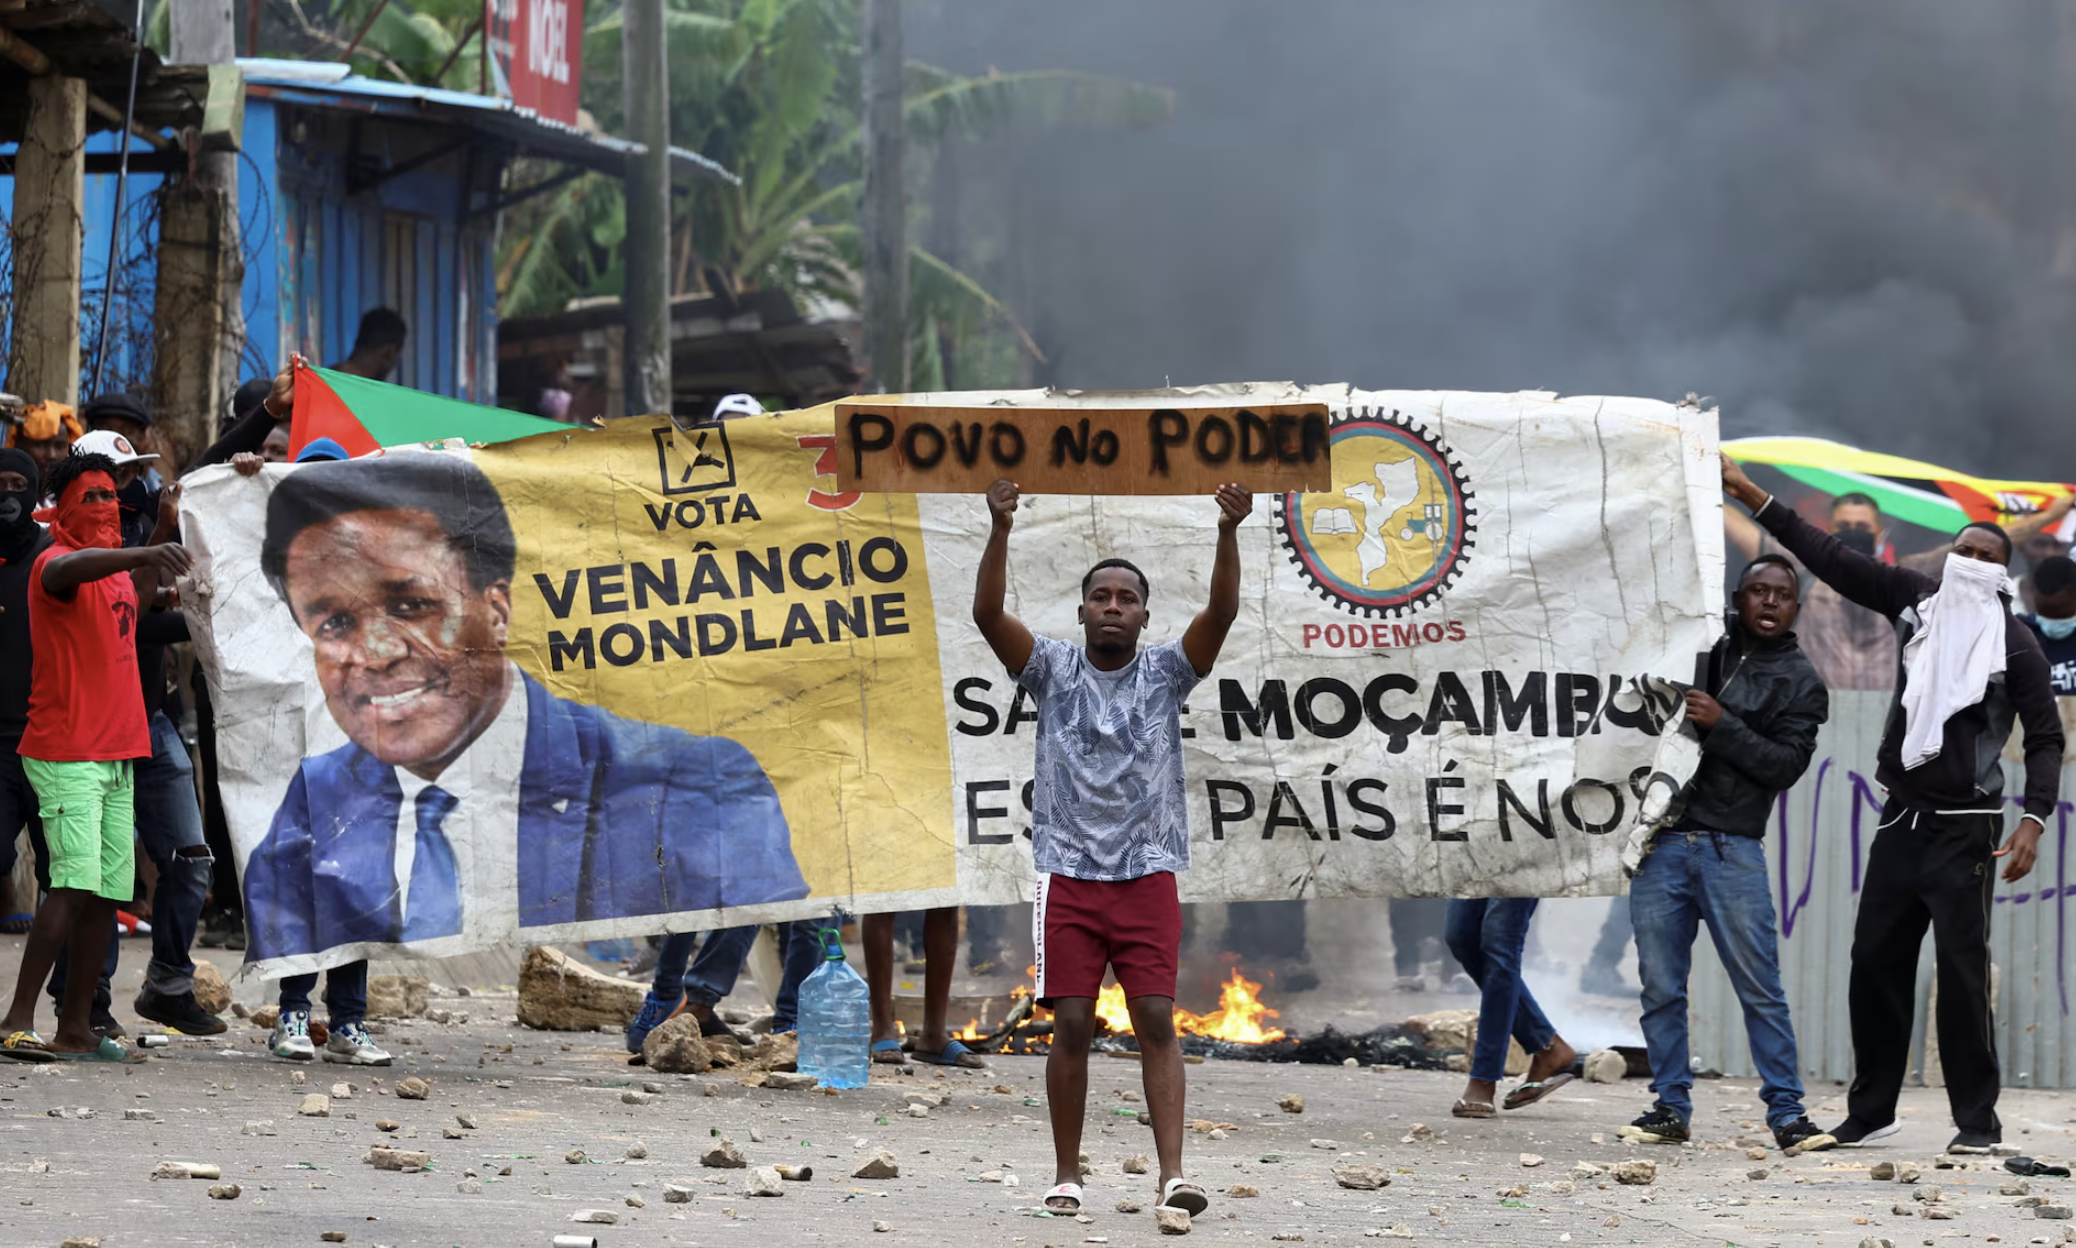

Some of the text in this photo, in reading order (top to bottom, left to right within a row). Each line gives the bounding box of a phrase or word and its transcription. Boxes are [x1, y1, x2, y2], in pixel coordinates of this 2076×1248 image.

[796, 433, 864, 512] 3
[847, 412, 1026, 479] POVO
[643, 493, 762, 531] VOTA
[532, 536, 909, 619] VENÂNCIO
[547, 592, 911, 672] MONDLANE
[1302, 620, 1467, 649] PODEMOS
[1205, 763, 1396, 843] PAÍS
[1425, 758, 1470, 843] É
